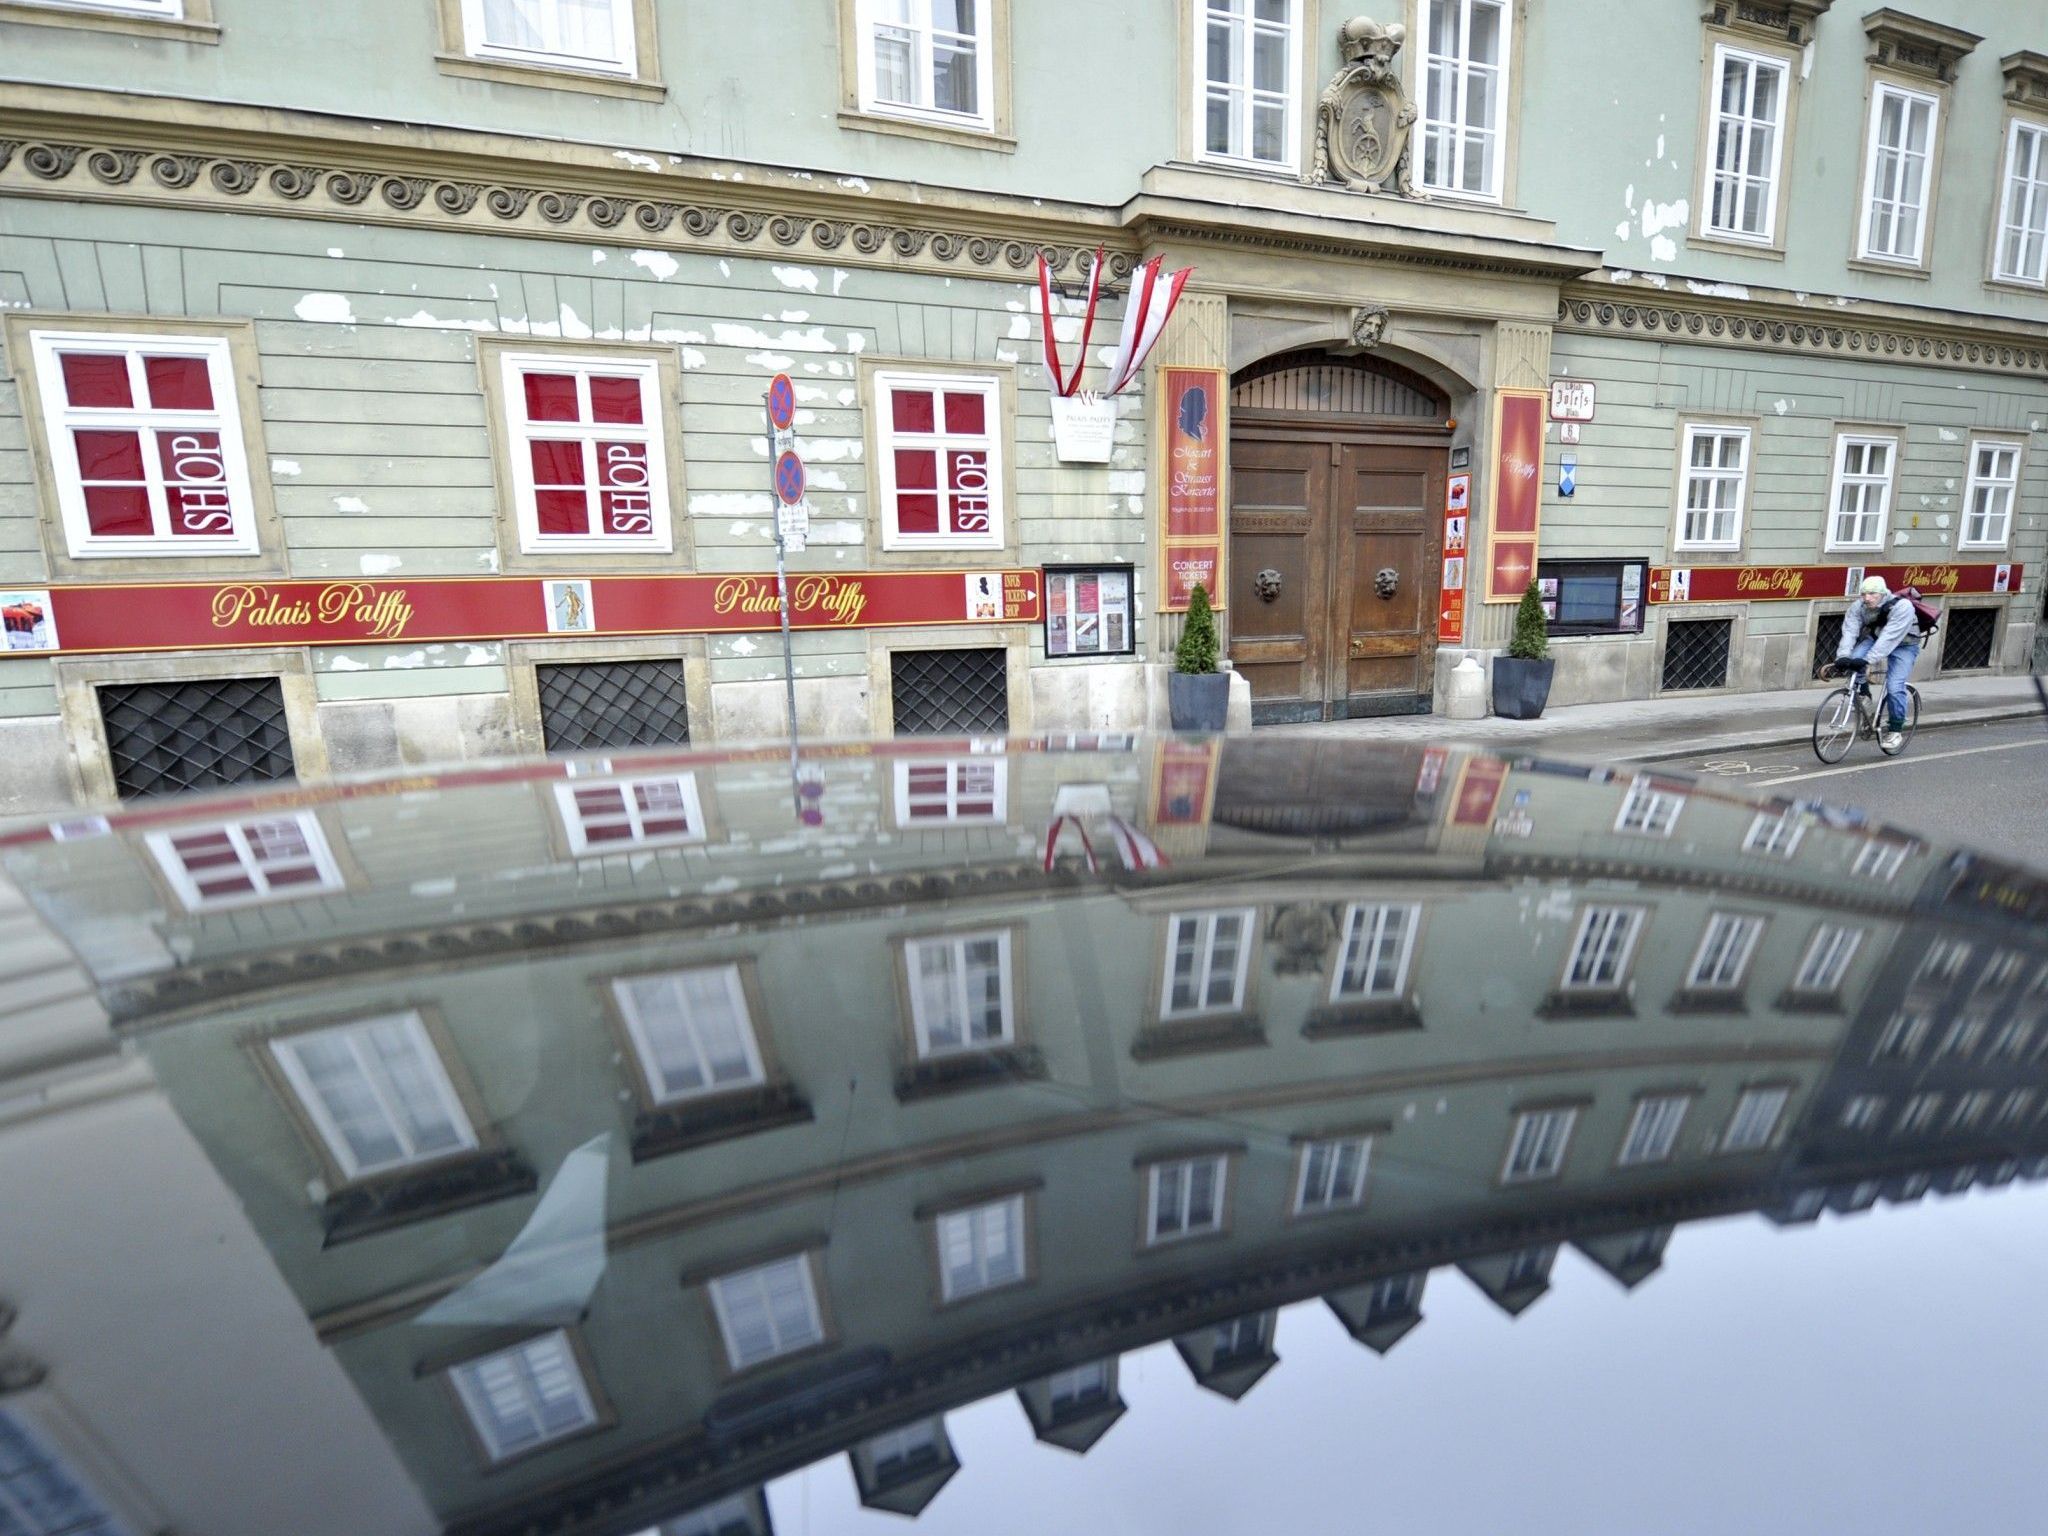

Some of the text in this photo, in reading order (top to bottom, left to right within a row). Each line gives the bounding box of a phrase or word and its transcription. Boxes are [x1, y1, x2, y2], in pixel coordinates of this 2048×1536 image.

[172, 436, 232, 531] SHOP
[607, 445, 652, 532] SHOP
[956, 454, 989, 530] SHOP
[1172, 560, 1214, 571] CONCERT
[1737, 567, 1803, 597] Palais Palffy
[211, 582, 415, 639] Palais Palffy
[794, 575, 867, 625] Palffy
